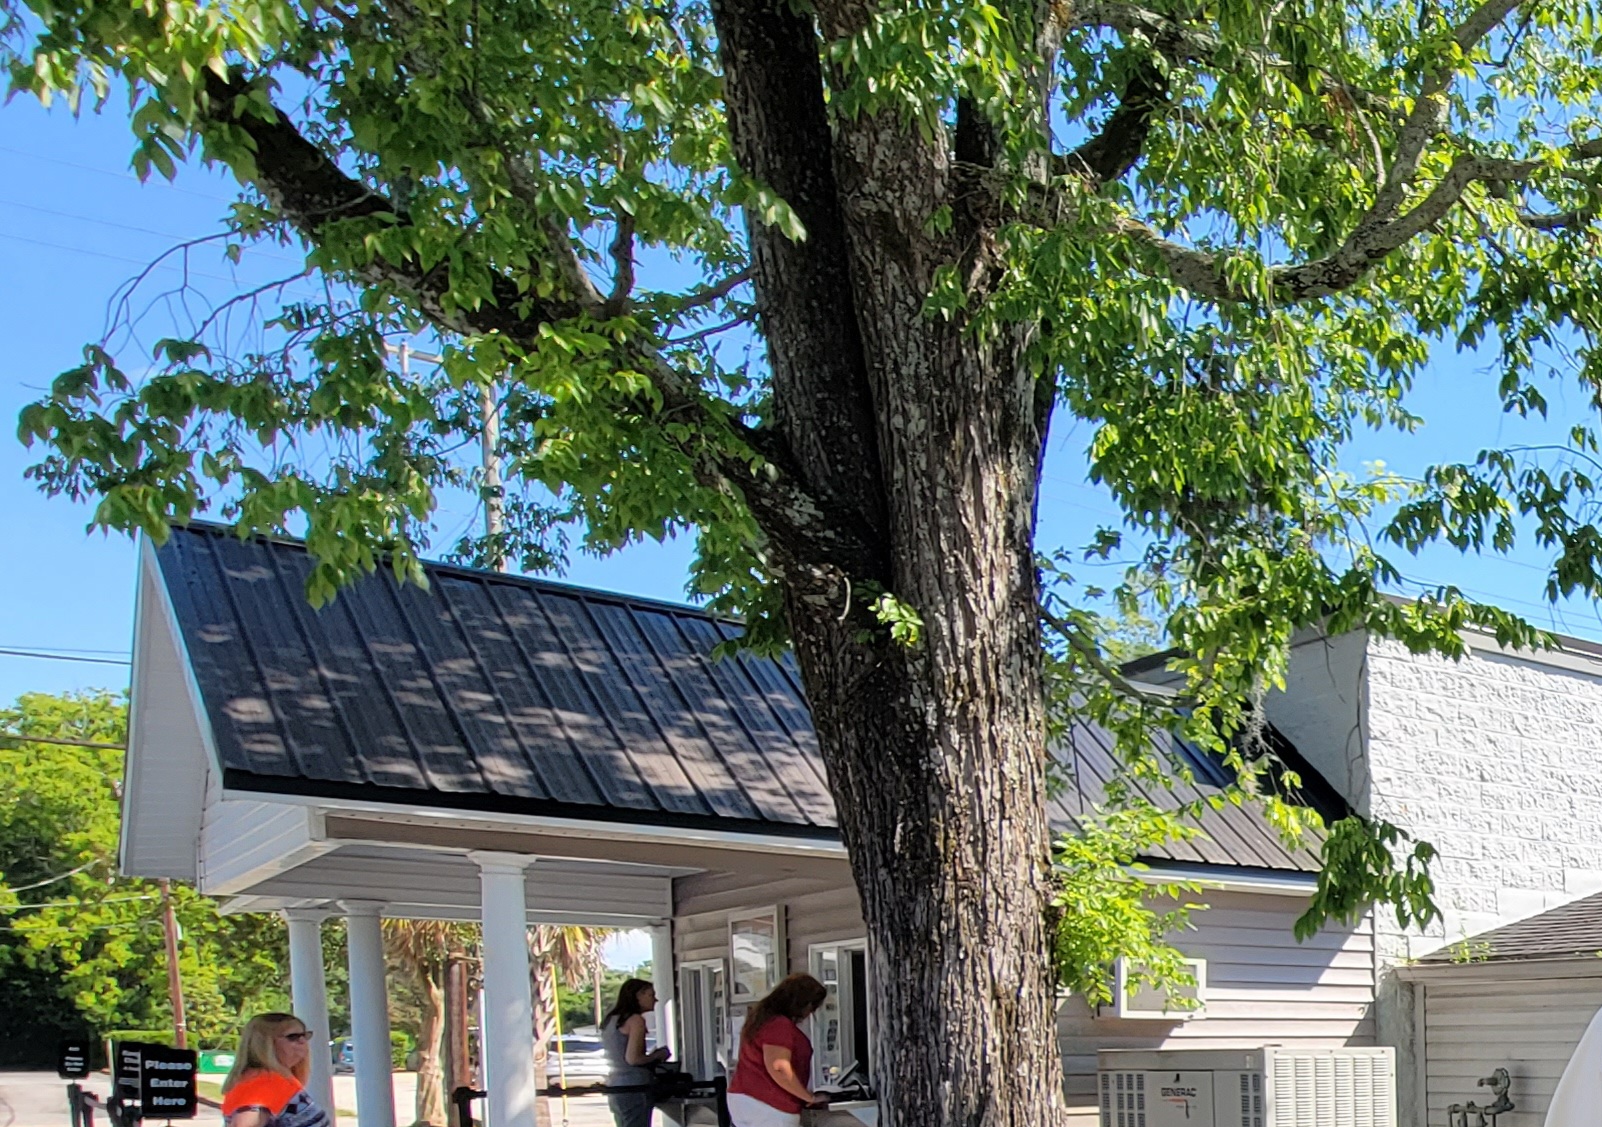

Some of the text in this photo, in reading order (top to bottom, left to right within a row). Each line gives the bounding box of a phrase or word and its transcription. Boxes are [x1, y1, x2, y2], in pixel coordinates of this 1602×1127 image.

[145, 1060, 193, 1070] Please
[150, 1078, 189, 1088] Enter
[152, 1096, 187, 1106] Here
